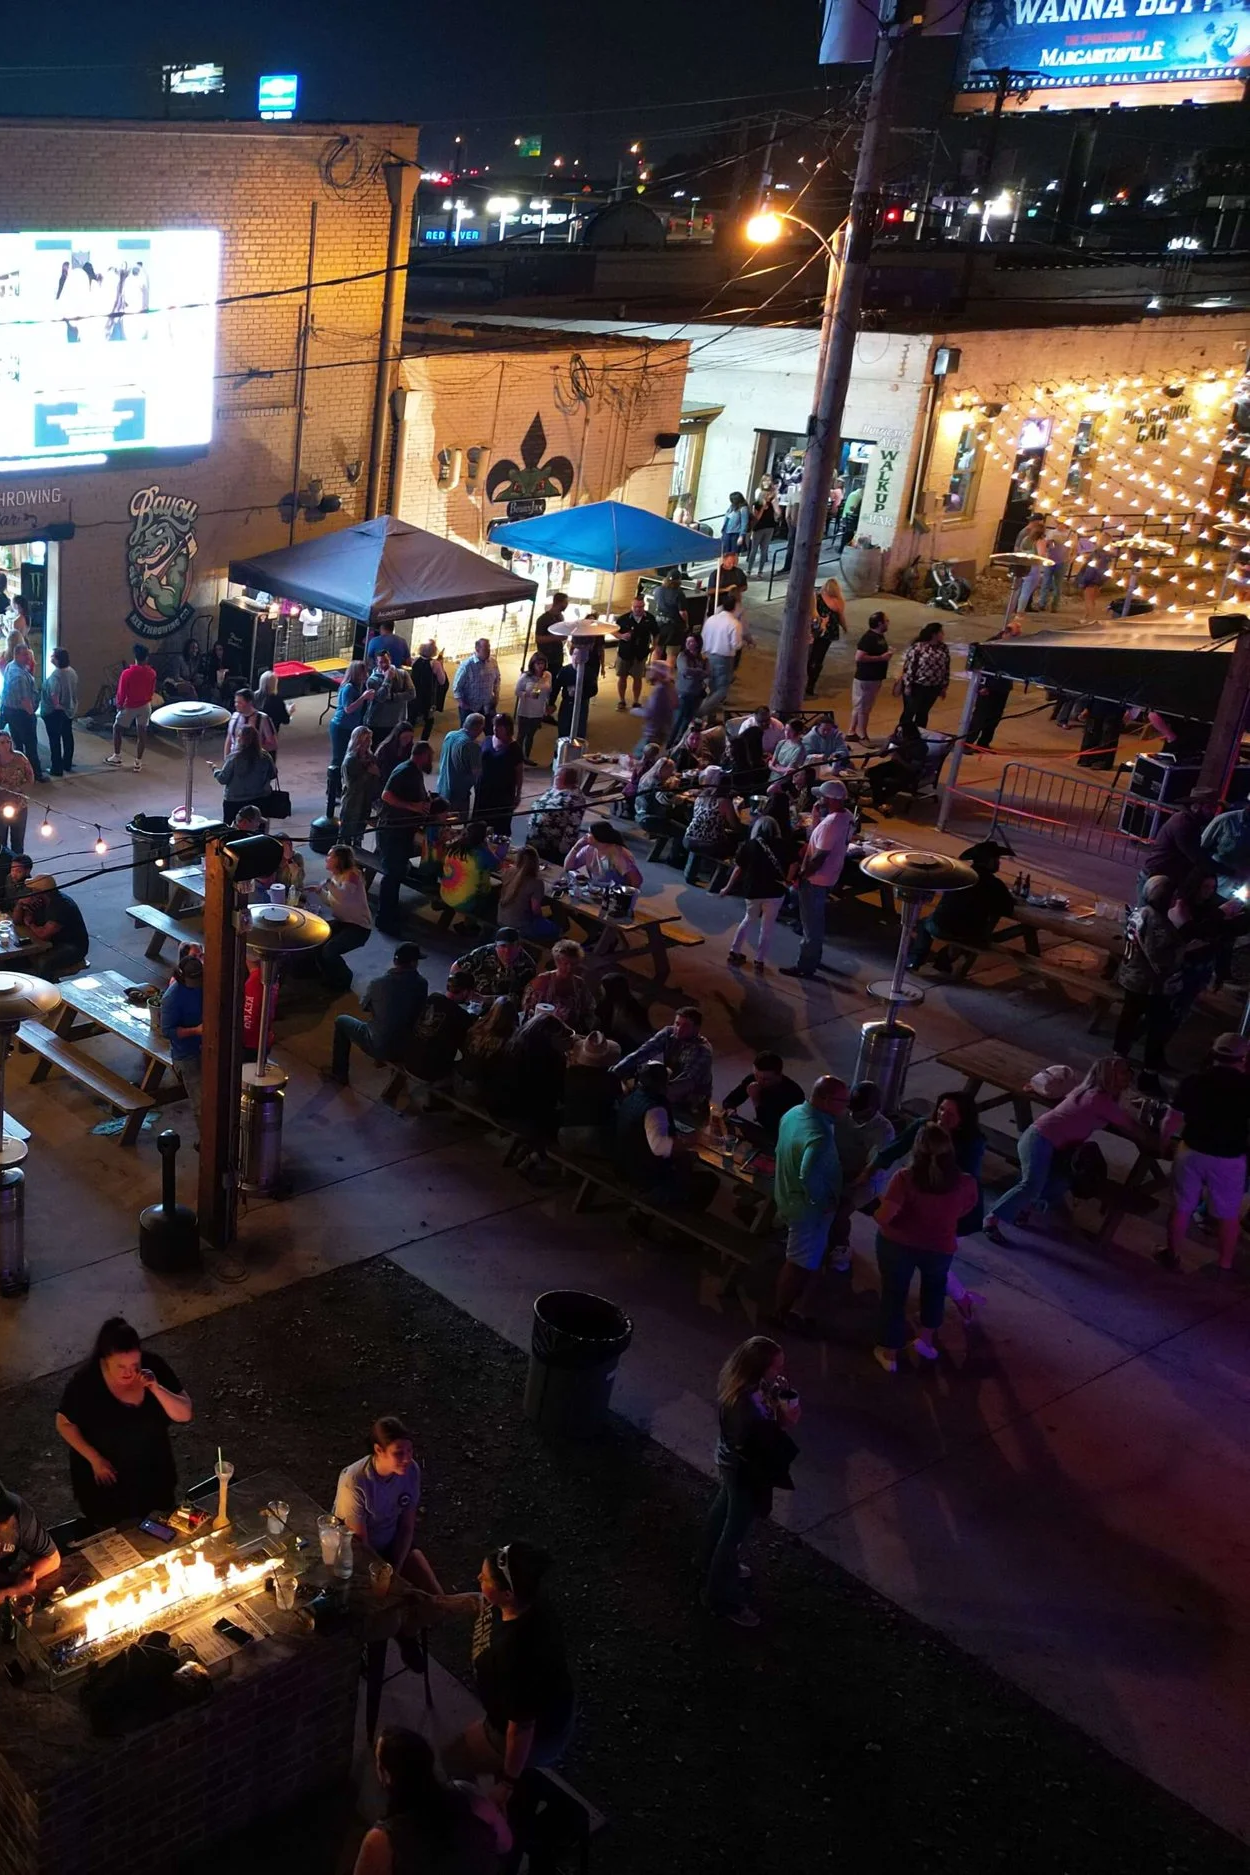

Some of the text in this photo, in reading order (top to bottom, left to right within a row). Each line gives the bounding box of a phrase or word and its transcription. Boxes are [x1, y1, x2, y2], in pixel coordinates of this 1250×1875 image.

[1013, 0, 1126, 25] WANNA
[425, 230, 445, 240] RED
[129, 485, 198, 545] Bayou
